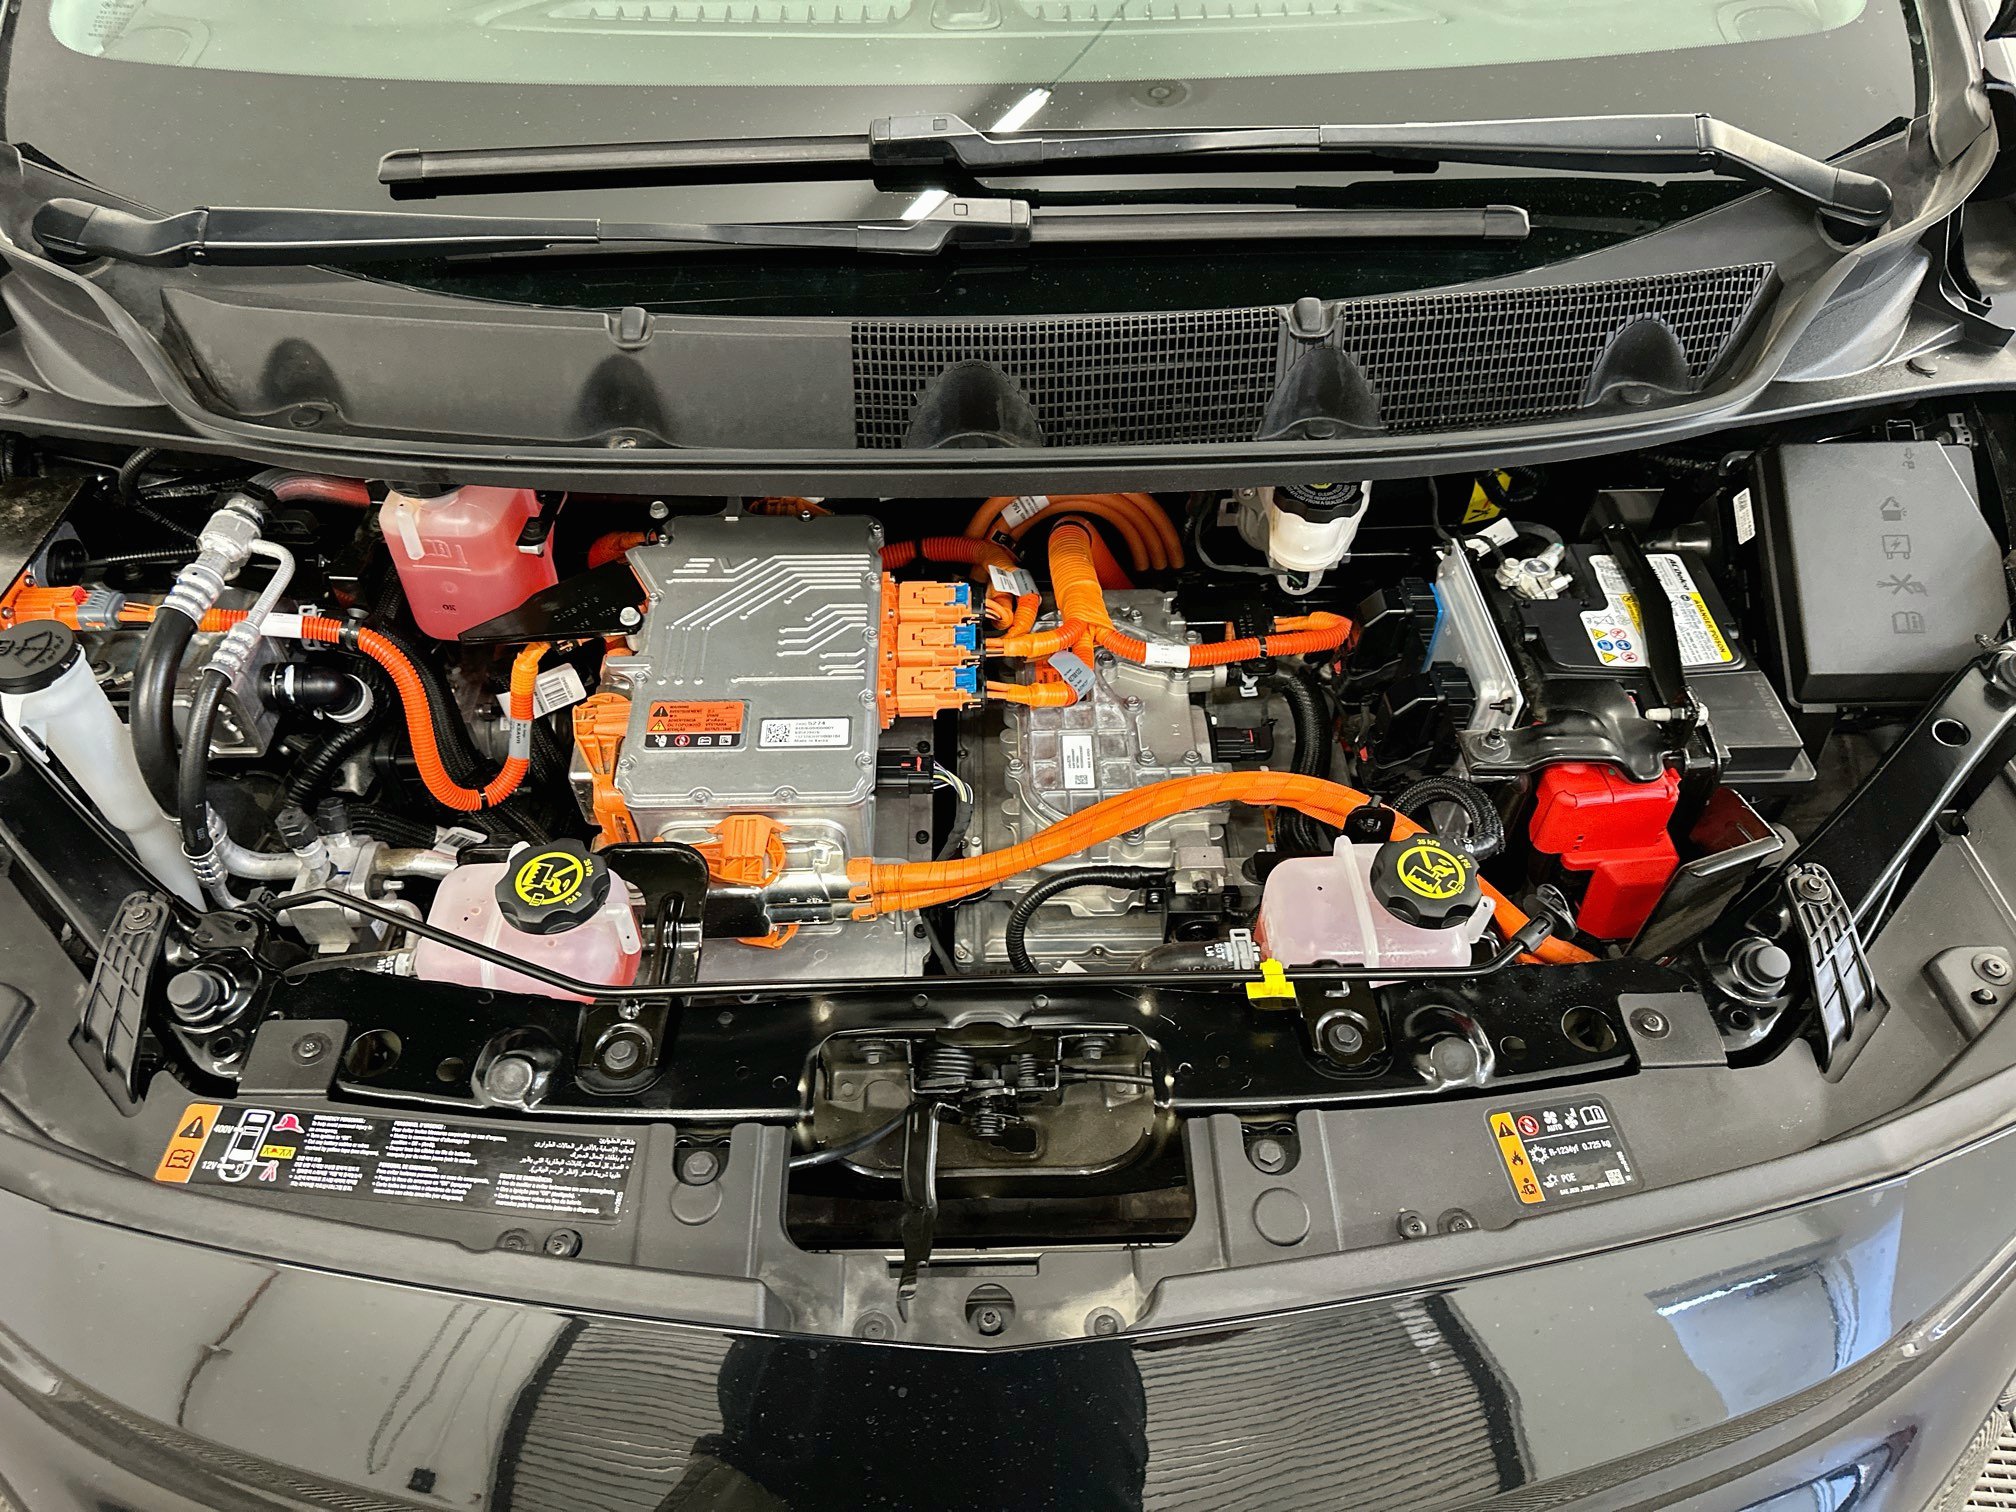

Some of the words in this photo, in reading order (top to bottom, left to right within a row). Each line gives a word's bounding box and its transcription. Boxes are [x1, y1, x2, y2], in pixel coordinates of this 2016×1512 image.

[1668, 557, 1690, 591] ACDelco
[213, 1124, 234, 1134] 400V
[1547, 1124, 1563, 1132] AUTO
[1549, 1144, 1579, 1156] R-1234yf
[1582, 1141, 1602, 1151] 0.725
[1602, 1139, 1612, 1148] kg
[201, 1161, 217, 1170] 12V
[1560, 1172, 1577, 1183] POE
